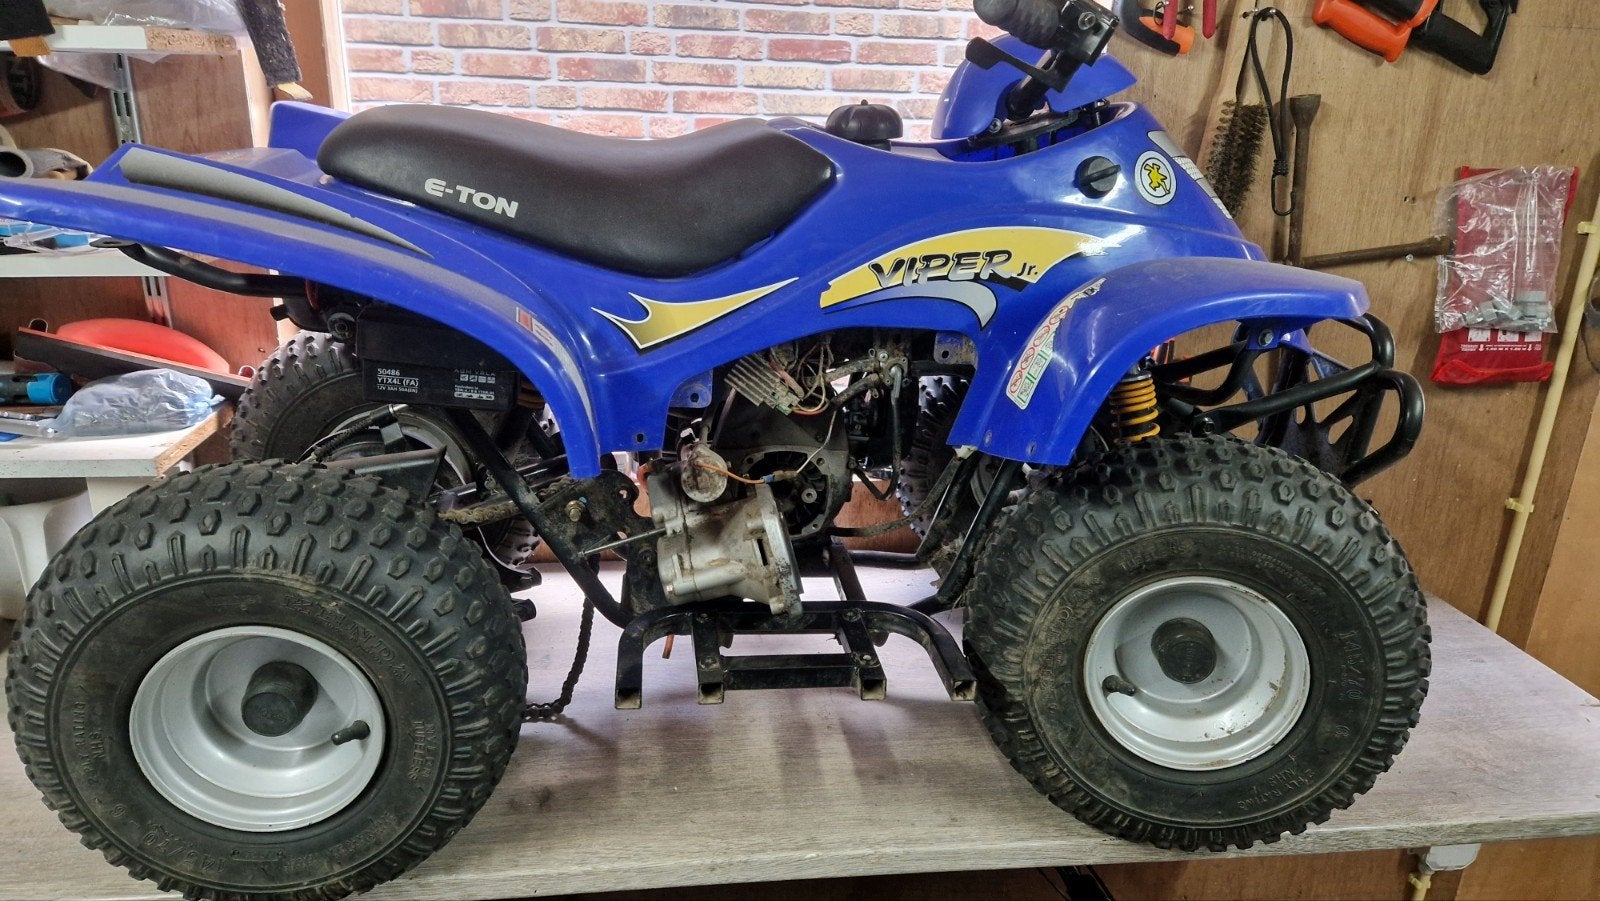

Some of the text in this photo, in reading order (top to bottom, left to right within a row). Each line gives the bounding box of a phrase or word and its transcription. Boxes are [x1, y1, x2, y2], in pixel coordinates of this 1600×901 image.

[424, 178, 519, 218] E-TON
[868, 249, 1038, 288] VIPER Jr.
[377, 368, 401, 376] 50486
[377, 377, 419, 387] YTX4L (FA)
